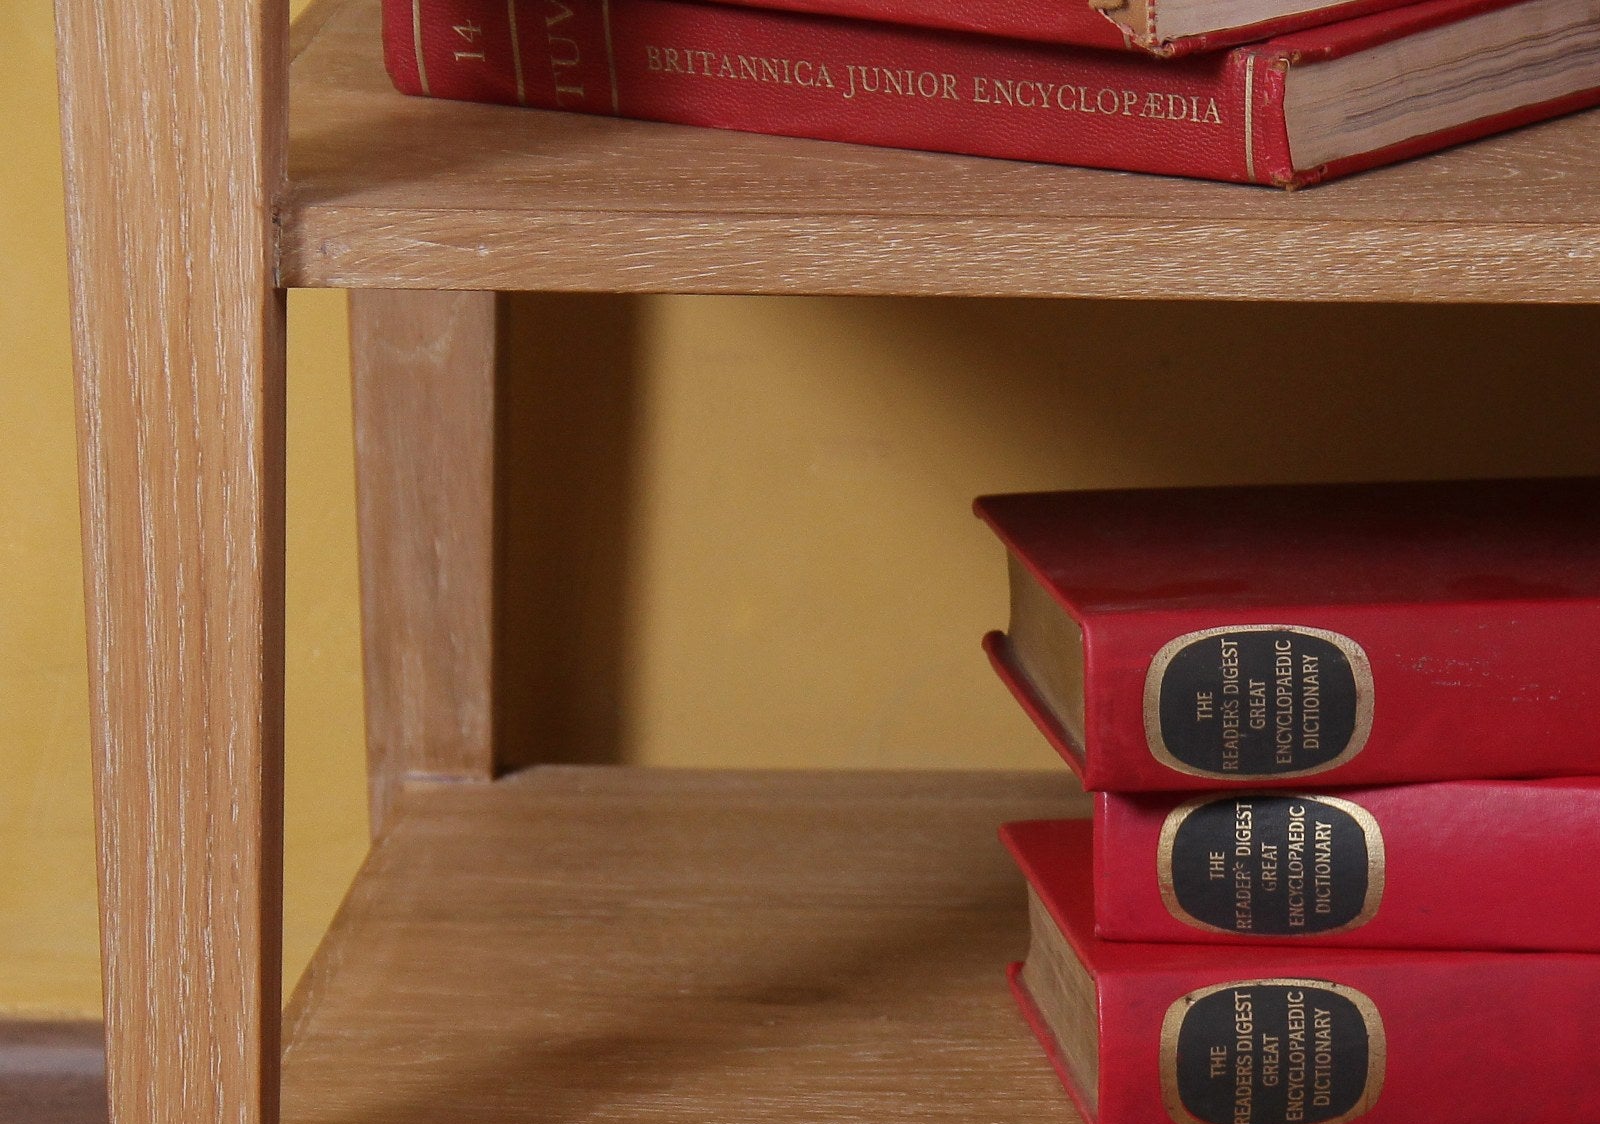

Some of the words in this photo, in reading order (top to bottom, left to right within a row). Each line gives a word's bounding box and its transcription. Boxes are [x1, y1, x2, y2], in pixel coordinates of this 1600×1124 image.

[452, 19, 486, 63] 14
[645, 45, 835, 88] BRITANNICA
[843, 65, 960, 100] JUNIOR
[973, 77, 1222, 125] ENCYCLOPÆDIA
[1221, 638, 1239, 694] DIGEST
[1197, 691, 1213, 721] THE
[1249, 678, 1266, 730] GREAT
[1275, 639, 1292, 764] ENCYCLOPAEDIC
[1302, 654, 1320, 749] DICTIONARY
[1221, 699, 1240, 770] READER'S
[1235, 802, 1252, 856] DIGEST
[1210, 850, 1225, 880] THE
[1261, 842, 1278, 892] GREAT
[1288, 805, 1305, 927] ENCYCLOPAEDIC
[1315, 820, 1332, 914] DICTIONARY
[1234, 990, 1253, 1051] DIGEST
[1210, 1045, 1227, 1078] THE
[1263, 1033, 1279, 1087] GREAT
[1286, 990, 1305, 1121] ENCYCLOPAEDIC
[1313, 1007, 1331, 1106] DICTIONARY
